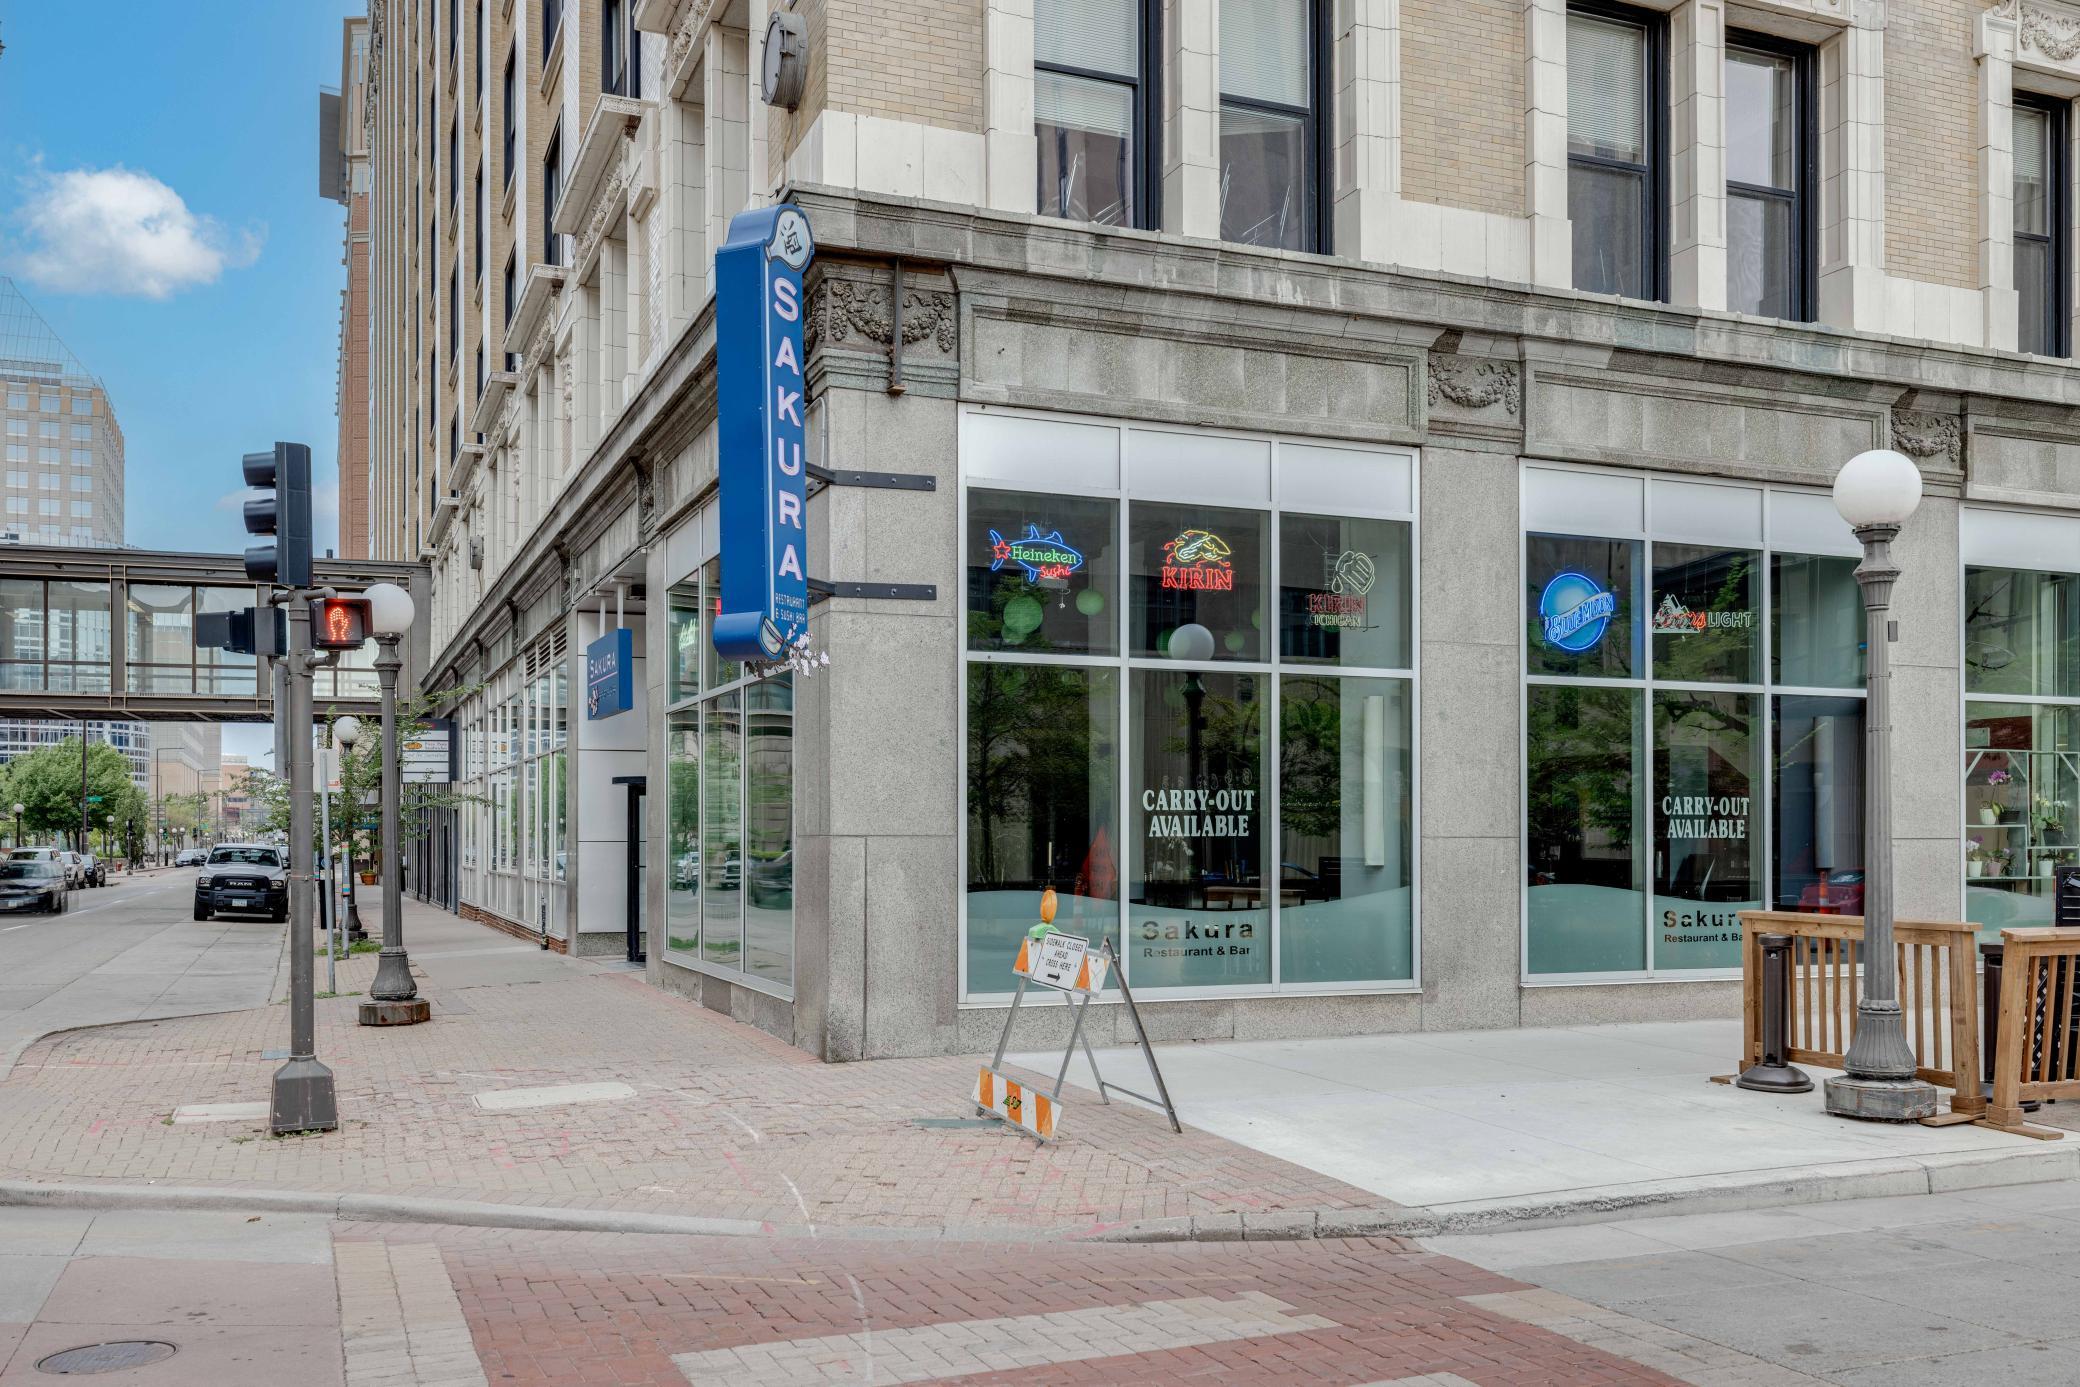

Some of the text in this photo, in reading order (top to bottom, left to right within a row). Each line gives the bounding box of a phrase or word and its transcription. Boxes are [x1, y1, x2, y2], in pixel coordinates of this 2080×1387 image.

[774, 277, 804, 582] SAKURA
[1011, 546, 1077, 564] Heineken
[1040, 564, 1071, 578] Sushi
[1162, 566, 1233, 591] KIRIN
[775, 593, 805, 609] RESTAURANT
[1309, 593, 1366, 614] KIRIN
[781, 608, 795, 622] SUSHI
[796, 613, 805, 624] BAR
[1549, 595, 1614, 642] BLUE MOON
[1708, 612, 1752, 628] LIGHT
[589, 651, 616, 679] SAKURA
[1142, 789, 1255, 811] CARRY-OUT
[1662, 796, 1750, 816] CARRY-OUT
[1148, 815, 1250, 837] AVAILABLE
[1667, 818, 1746, 839] AVAILABLE
[1142, 920, 1254, 941] Sakura
[1664, 933, 1743, 943] Restaurant & Ba
[1047, 937, 1084, 952] SIDEWALK CLOSED
[1143, 945, 1250, 958] Restaurant & Bar
[1046, 959, 1072, 971] CROSS HERE
[1054, 951, 1068, 960] AHEAD
